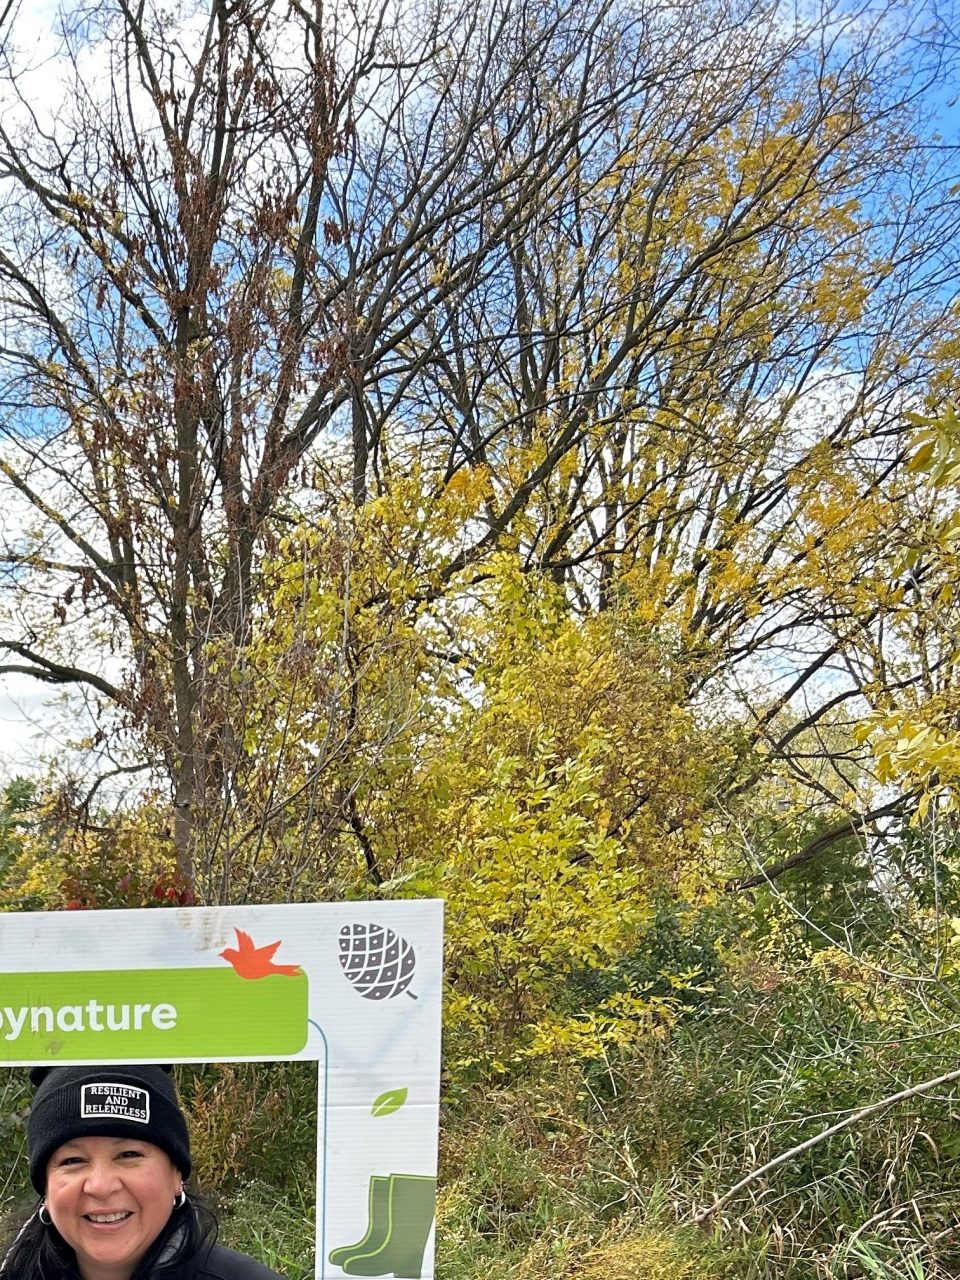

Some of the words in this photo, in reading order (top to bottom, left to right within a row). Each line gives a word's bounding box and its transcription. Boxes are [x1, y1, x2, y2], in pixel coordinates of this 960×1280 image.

[91, 1086, 141, 1099] RESILIENT
[105, 1096, 128, 1105] AND
[85, 1105, 146, 1118] RELENTLESS
